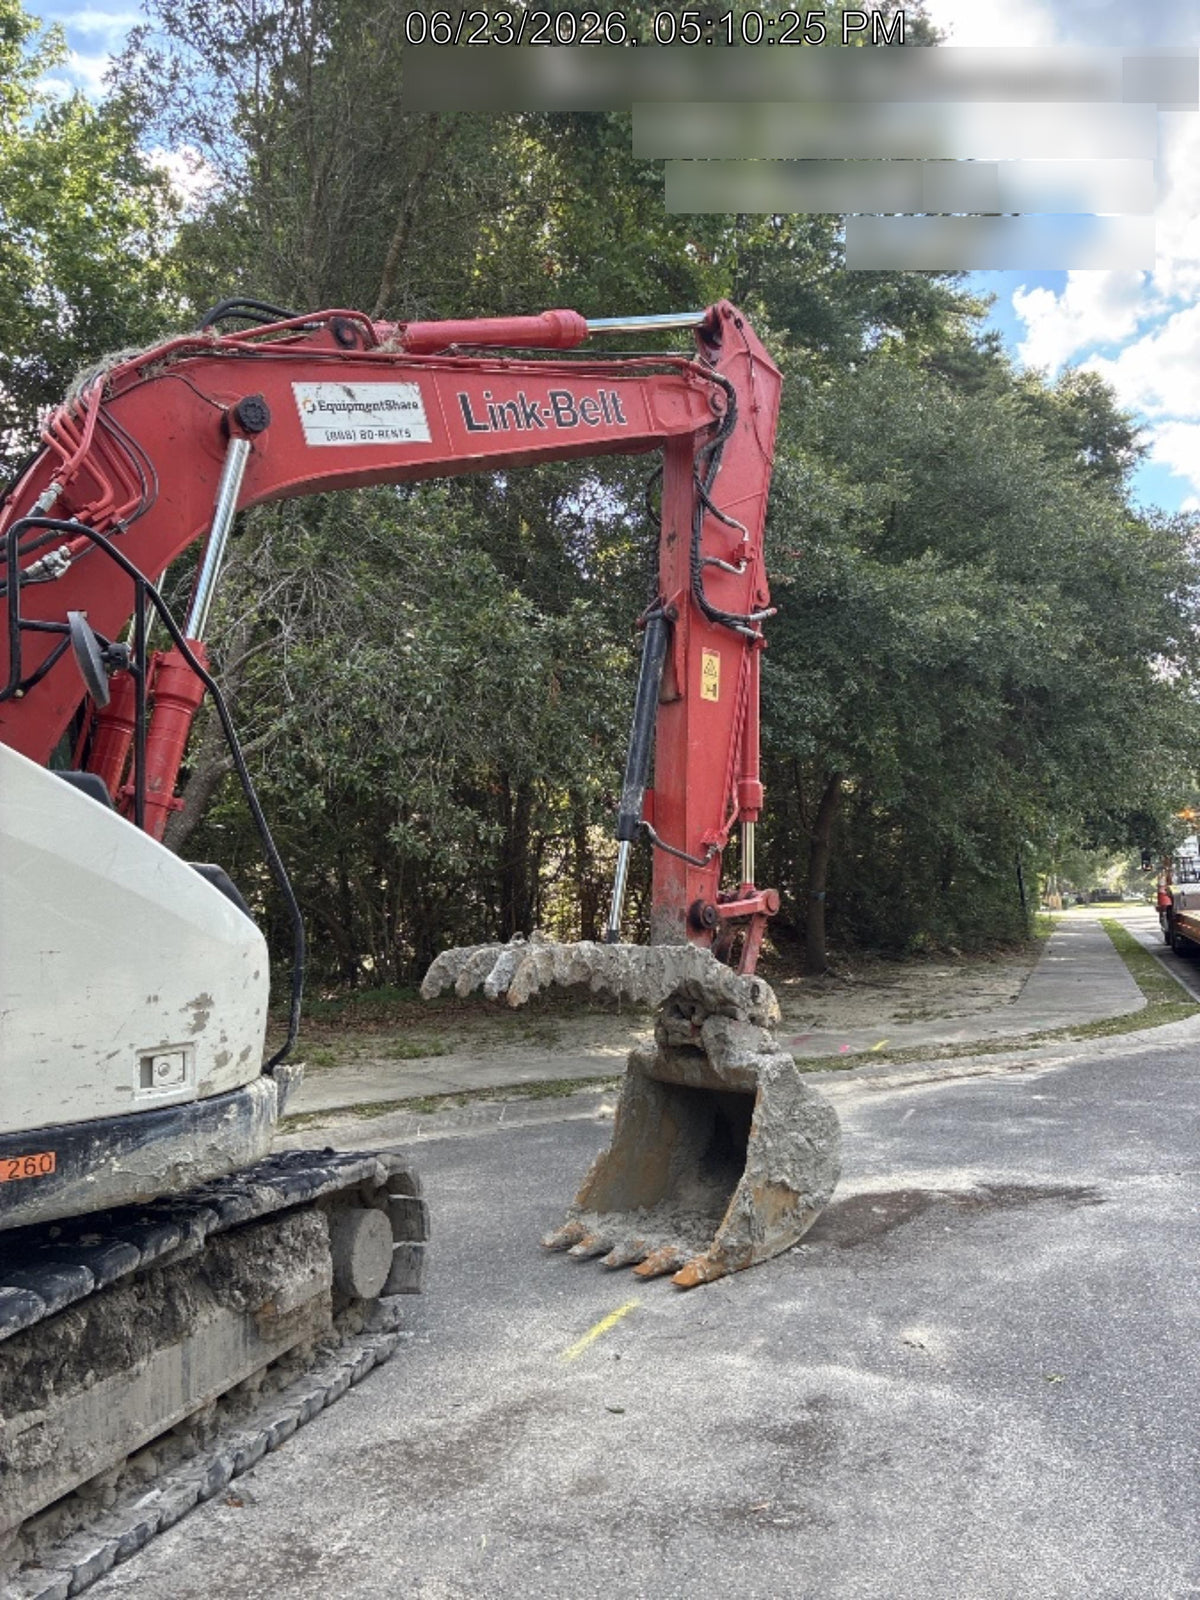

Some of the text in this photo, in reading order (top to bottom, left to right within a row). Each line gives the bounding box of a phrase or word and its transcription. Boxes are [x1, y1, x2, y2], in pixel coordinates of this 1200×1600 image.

[318, 399, 419, 415] EquipmentShare
[457, 388, 627, 432] Link-Belt
[7, 1154, 53, 1179] 260
